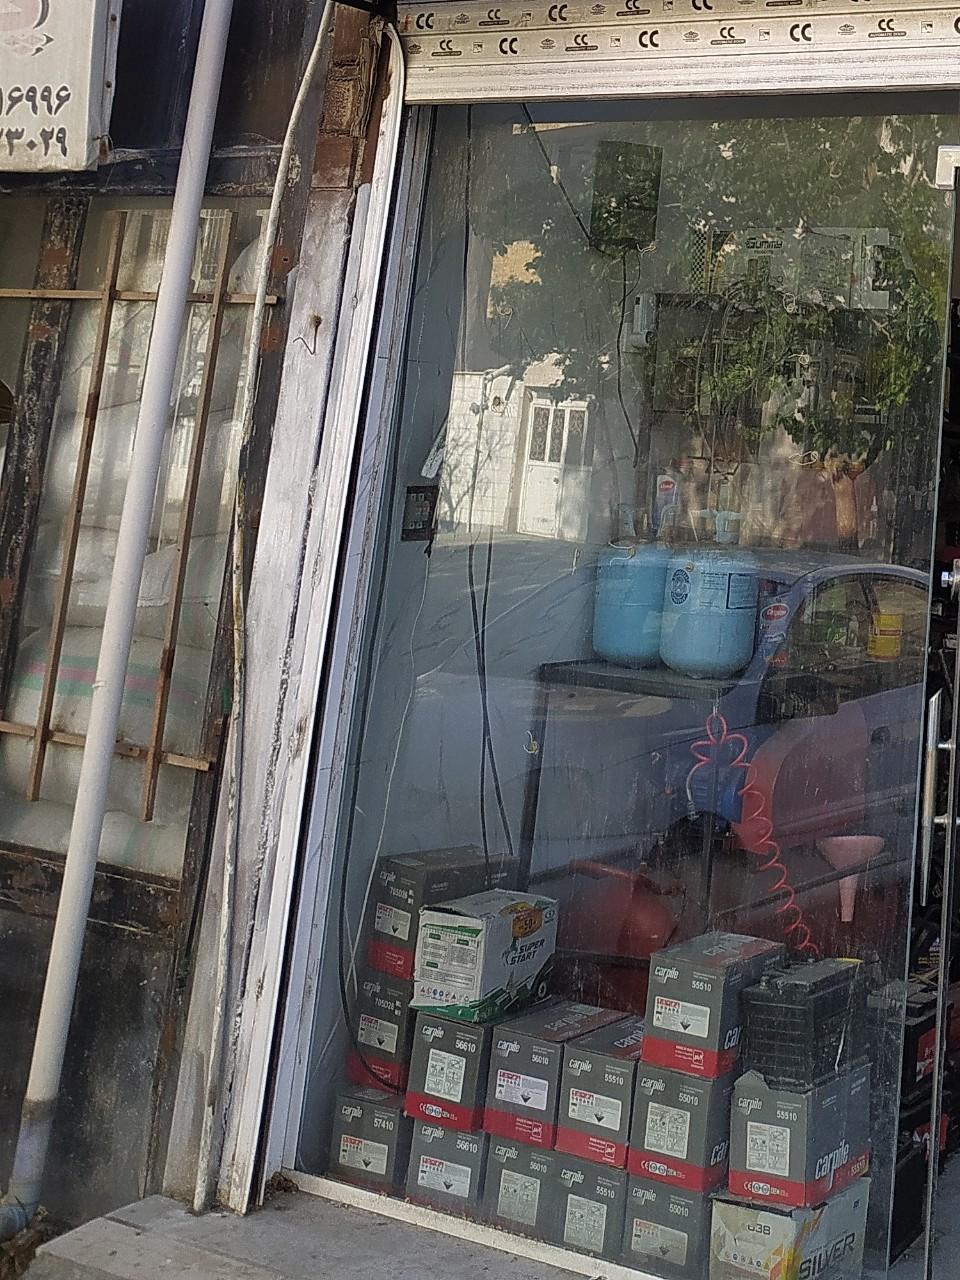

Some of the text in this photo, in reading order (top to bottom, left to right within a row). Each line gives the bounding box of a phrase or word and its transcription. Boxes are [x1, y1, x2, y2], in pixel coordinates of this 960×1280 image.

[519, 939, 545, 953] SUPER
[510, 950, 538, 965] START
[654, 966, 679, 983] carpile
[692, 980, 712, 992] 55510
[422, 1025, 444, 1042] carpile
[455, 1040, 476, 1053] 56610
[497, 1040, 520, 1057] carpile
[569, 1058, 592, 1076] carpile
[604, 1074, 624, 1085] 55510
[641, 1077, 666, 1095] carpile
[341, 1104, 363, 1122] carpile
[738, 1097, 762, 1115] carpile
[776, 1110, 797, 1120] 55510
[373, 1118, 394, 1130] 57410
[421, 1125, 445, 1142] carpile
[456, 1140, 478, 1153] 56610
[495, 1145, 518, 1163] carpile
[815, 1139, 850, 1191] carpile
[561, 1169, 584, 1188] carpile
[596, 1186, 615, 1198] 55510
[632, 1186, 656, 1205] carpile
